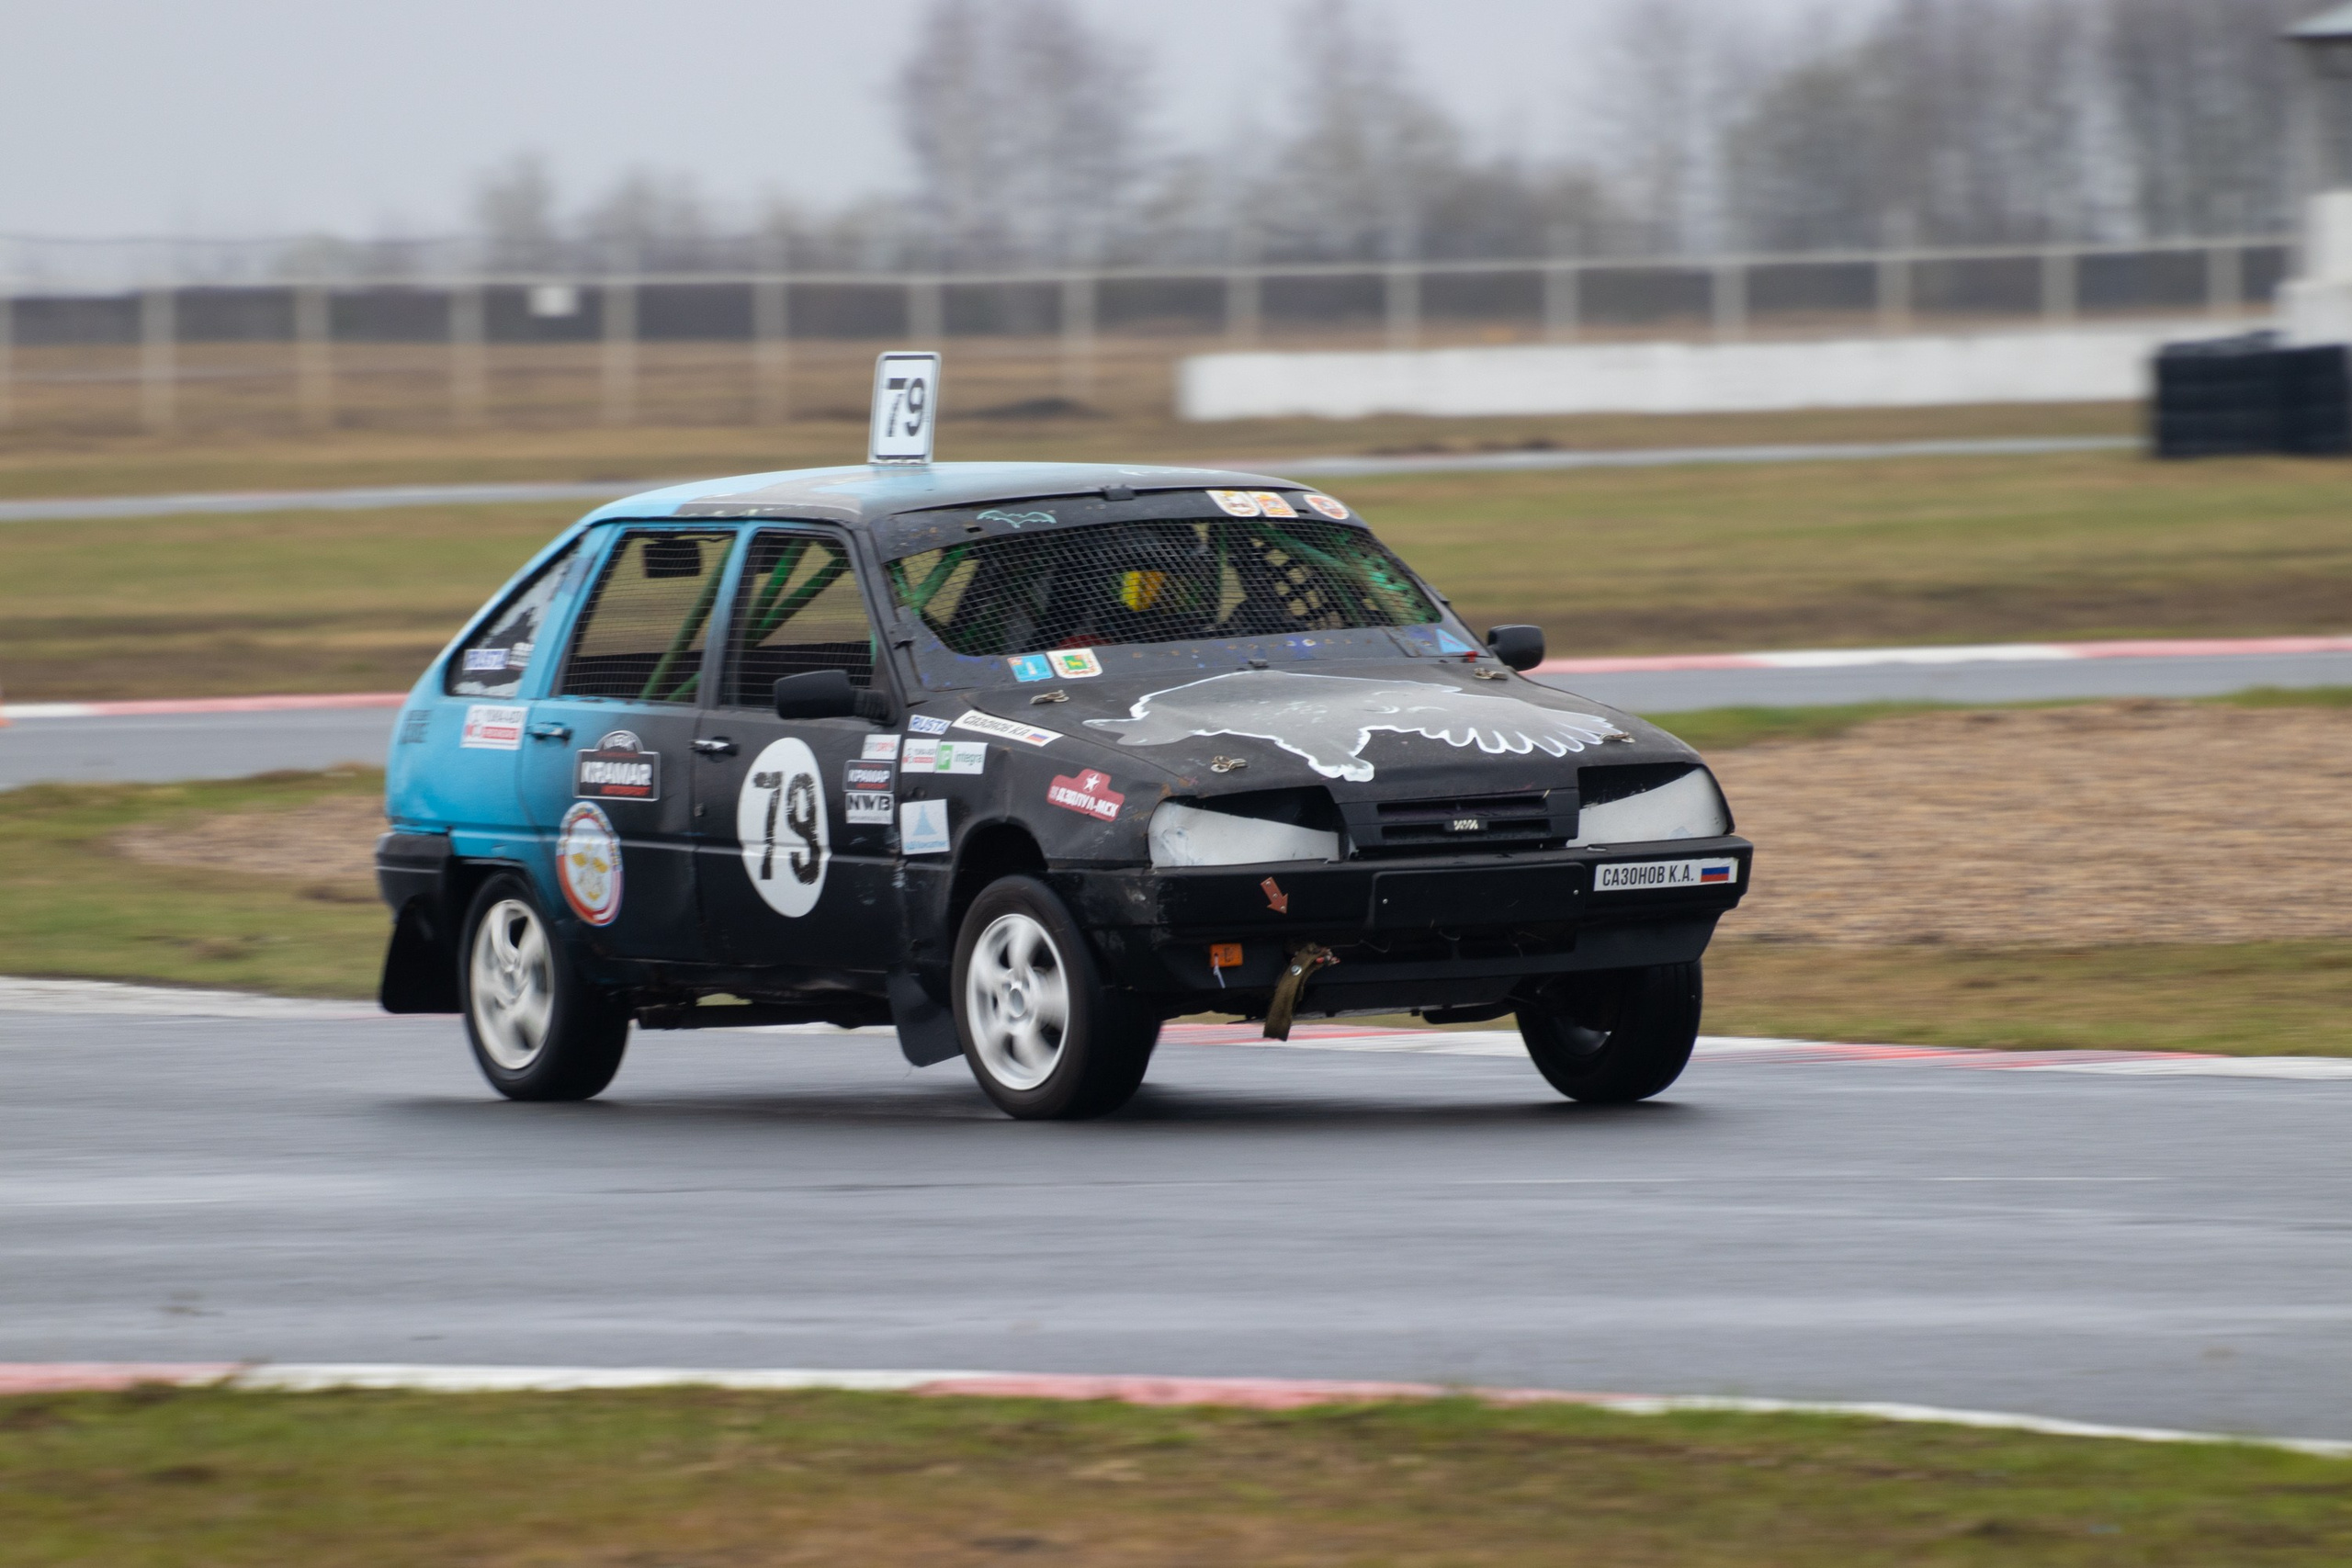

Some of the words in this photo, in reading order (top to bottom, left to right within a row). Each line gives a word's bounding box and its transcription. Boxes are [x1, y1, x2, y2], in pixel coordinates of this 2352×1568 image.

[887, 378, 926, 437] 79
[910, 716, 948, 733] RUSTA
[963, 715, 1011, 734] САЗОНОВ
[955, 749, 983, 767] integra
[753, 770, 821, 886] 79
[1602, 865, 1666, 886] САЗОНОВ
[1668, 863, 1695, 883] К.А.
